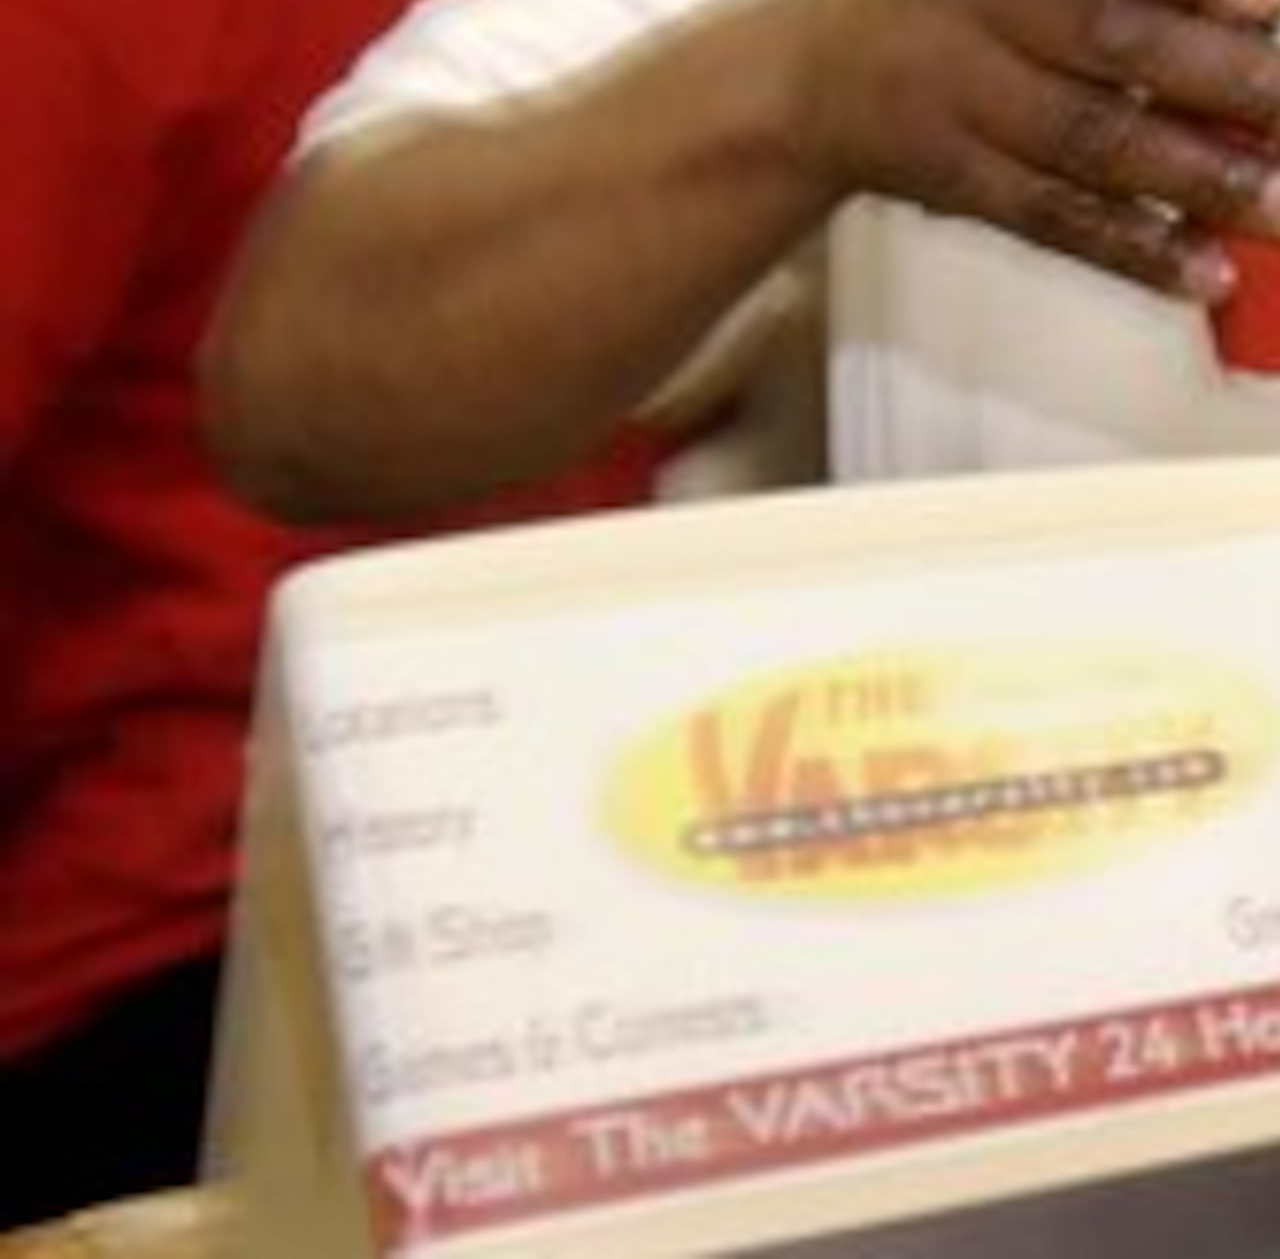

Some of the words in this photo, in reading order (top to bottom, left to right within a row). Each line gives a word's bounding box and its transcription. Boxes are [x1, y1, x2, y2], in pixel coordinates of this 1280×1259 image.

[380, 1140, 546, 1224] Visit
[565, 1105, 712, 1178] The
[726, 1042, 1086, 1142] VARSITY
[1098, 1020, 1186, 1084] 24
